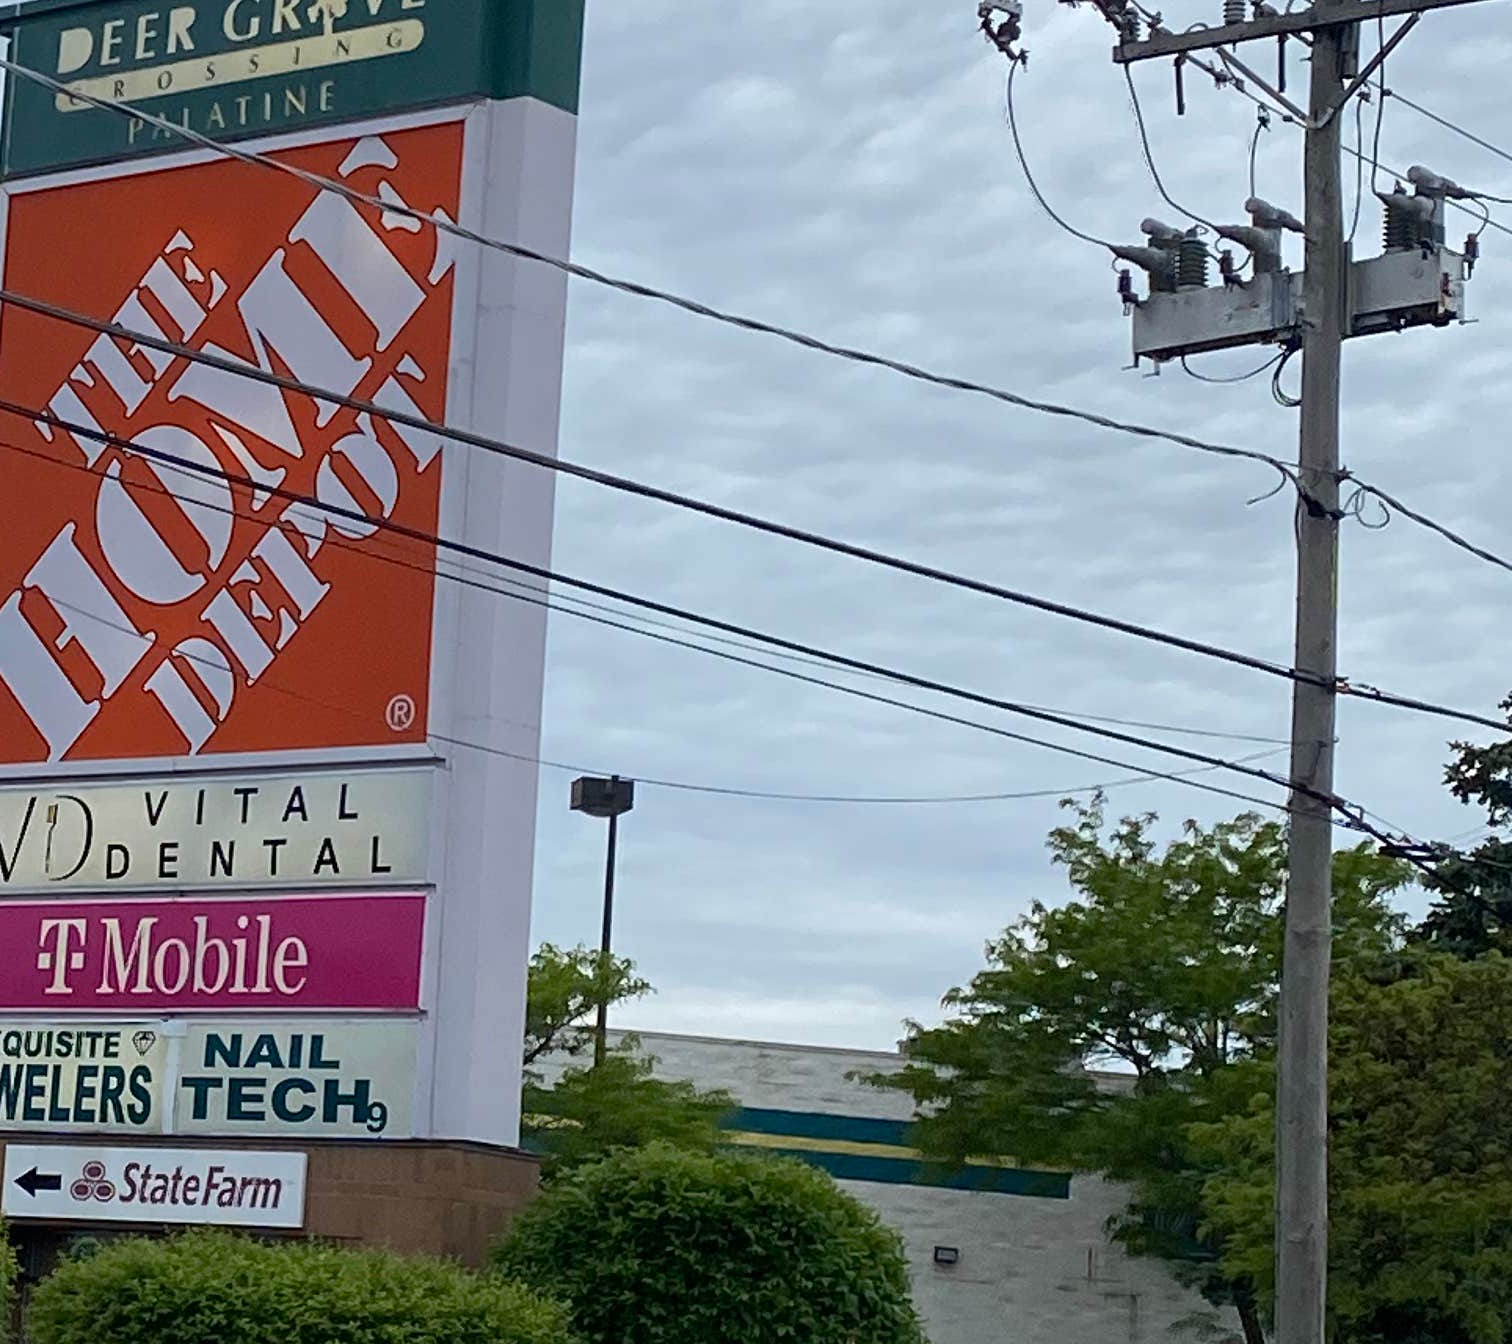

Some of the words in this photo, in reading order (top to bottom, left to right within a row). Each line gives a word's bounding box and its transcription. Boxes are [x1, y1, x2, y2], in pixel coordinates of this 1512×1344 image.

[57, 6, 196, 74] DEER
[34, 229, 229, 469] THE
[142, 354, 444, 756] DEPOT
[144, 783, 359, 827] VITAL
[105, 836, 392, 880] DENTAL
[203, 1033, 340, 1069] NAIL
